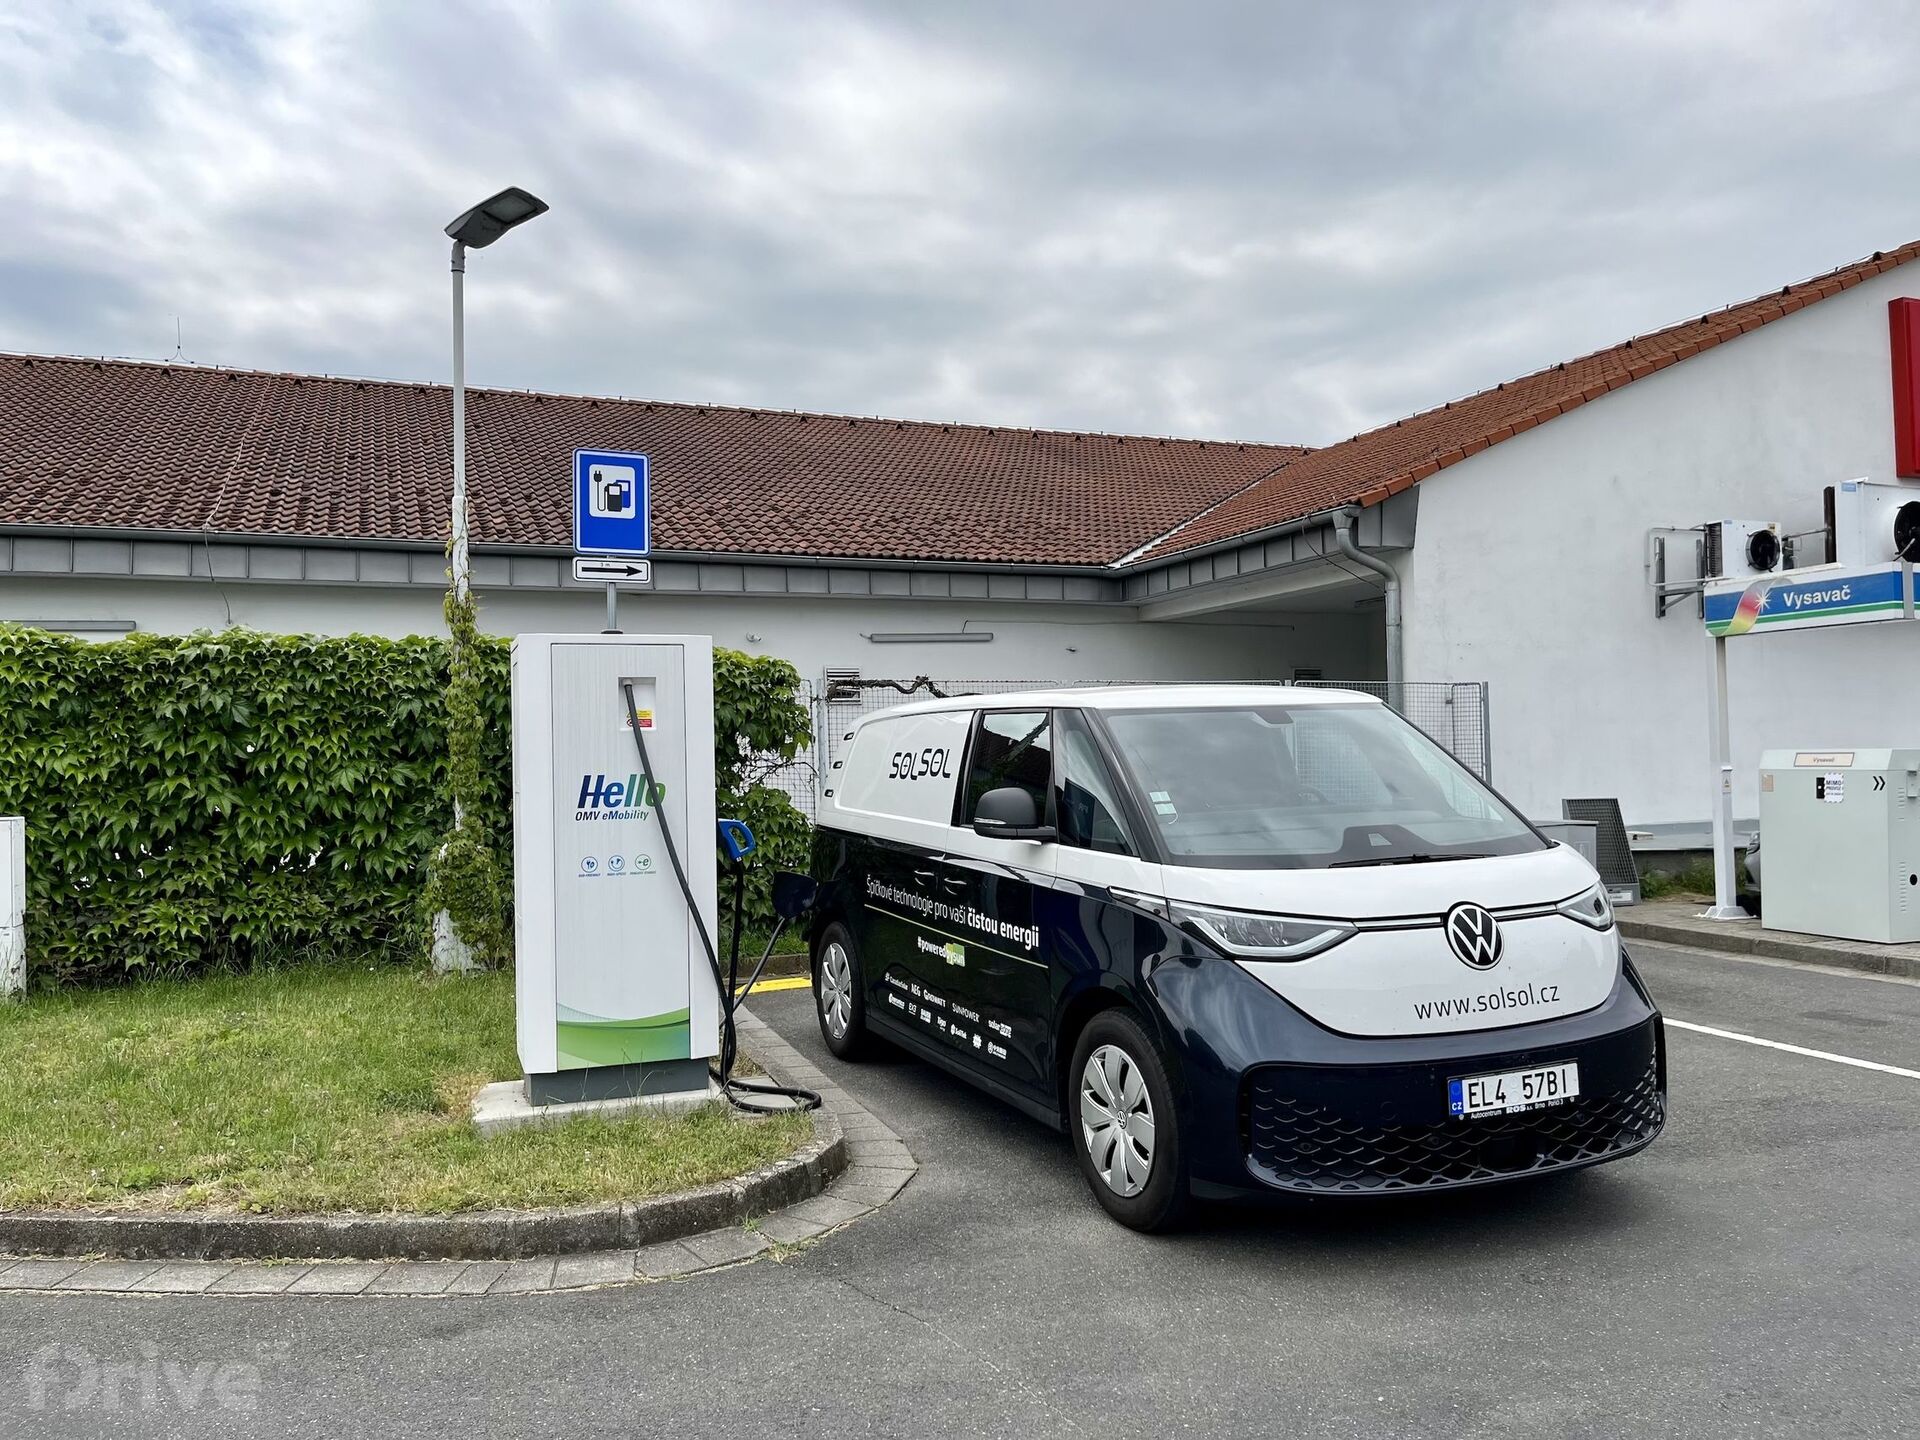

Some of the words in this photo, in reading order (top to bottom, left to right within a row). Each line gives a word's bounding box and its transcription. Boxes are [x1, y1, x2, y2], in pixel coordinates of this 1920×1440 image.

[1782, 584, 1851, 610] Vysavač
[577, 773, 666, 809] Hello
[575, 810, 600, 821] OMV
[602, 809, 649, 821] eMobility
[866, 874, 893, 901] Špičkové
[893, 886, 934, 917] technologie
[934, 901, 948, 920] pro
[949, 904, 966, 925] vaši
[967, 906, 998, 935] čistou
[1000, 920, 1039, 951] energii
[1414, 983, 1560, 1020] www.solsol.cz
[1451, 1101, 1463, 1111] CZ
[1468, 1079, 1507, 1109] EL4
[1470, 1110, 1502, 1120] Autocentrum
